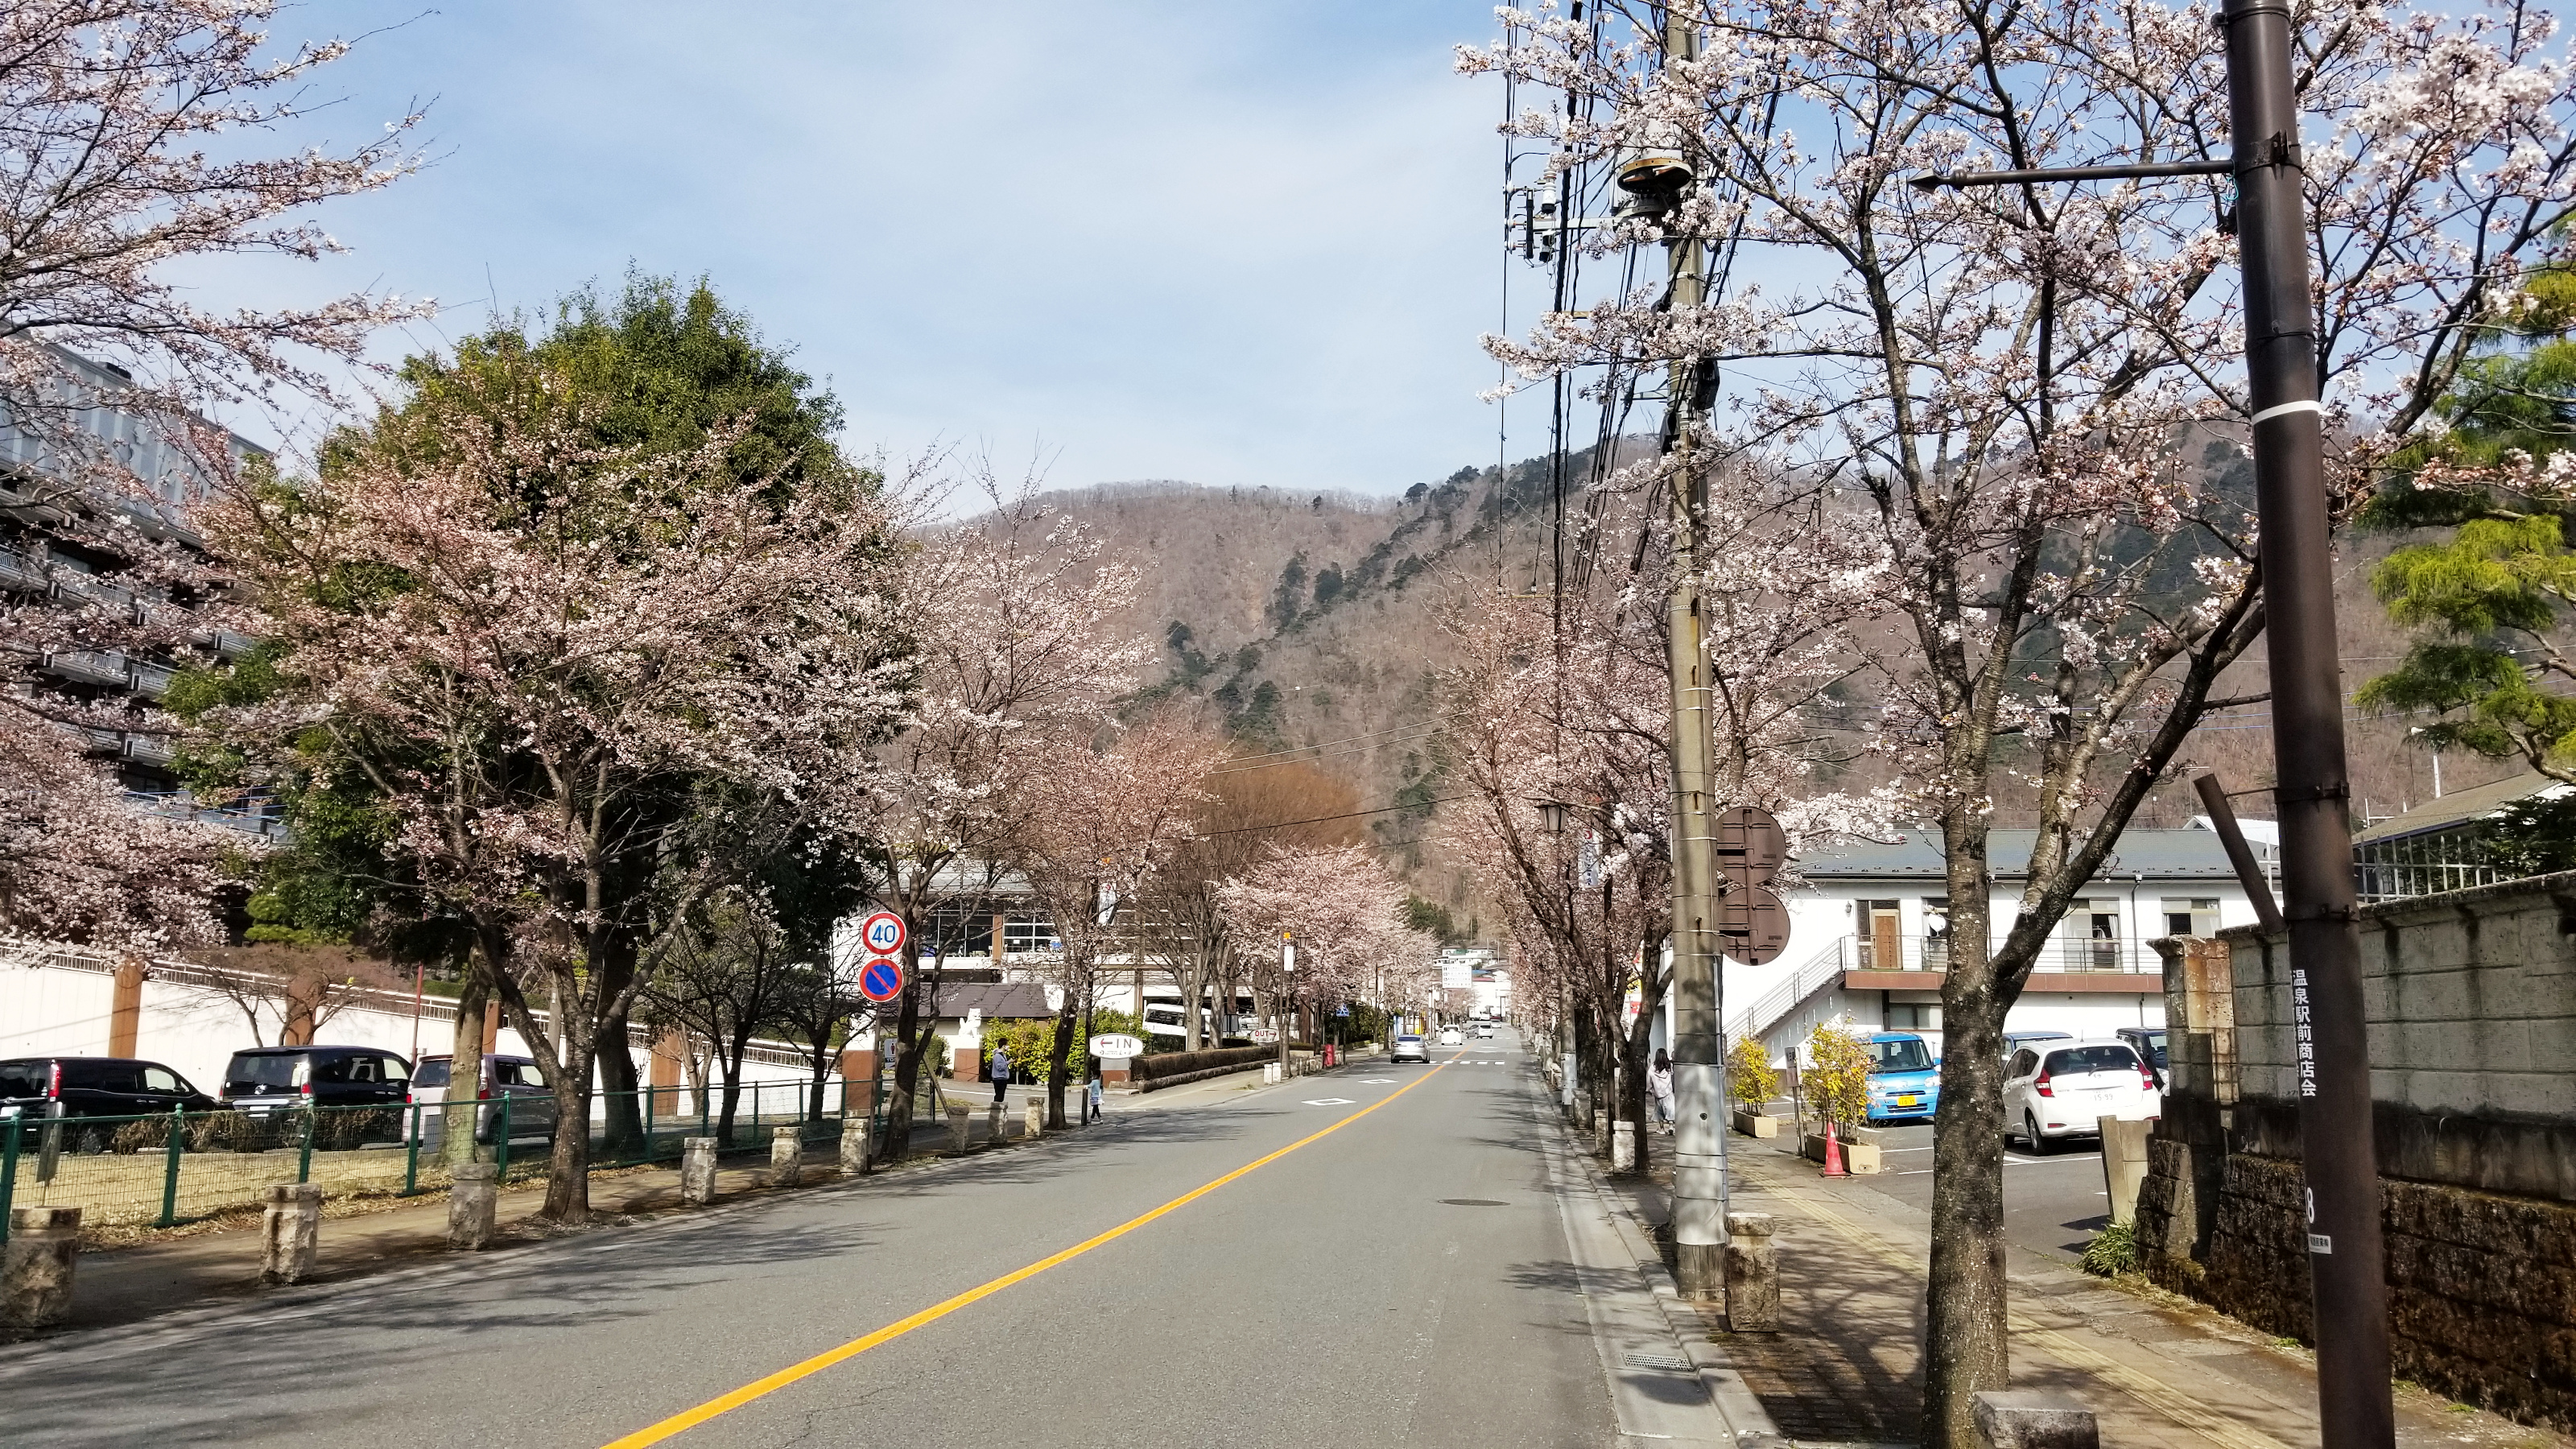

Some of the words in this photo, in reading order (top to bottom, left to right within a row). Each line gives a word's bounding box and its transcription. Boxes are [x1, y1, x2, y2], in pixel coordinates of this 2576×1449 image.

[872, 925, 895, 943] 40
[2293, 969, 2317, 1096] 温泉駅前商店会
[1116, 1038, 1132, 1048] IN
